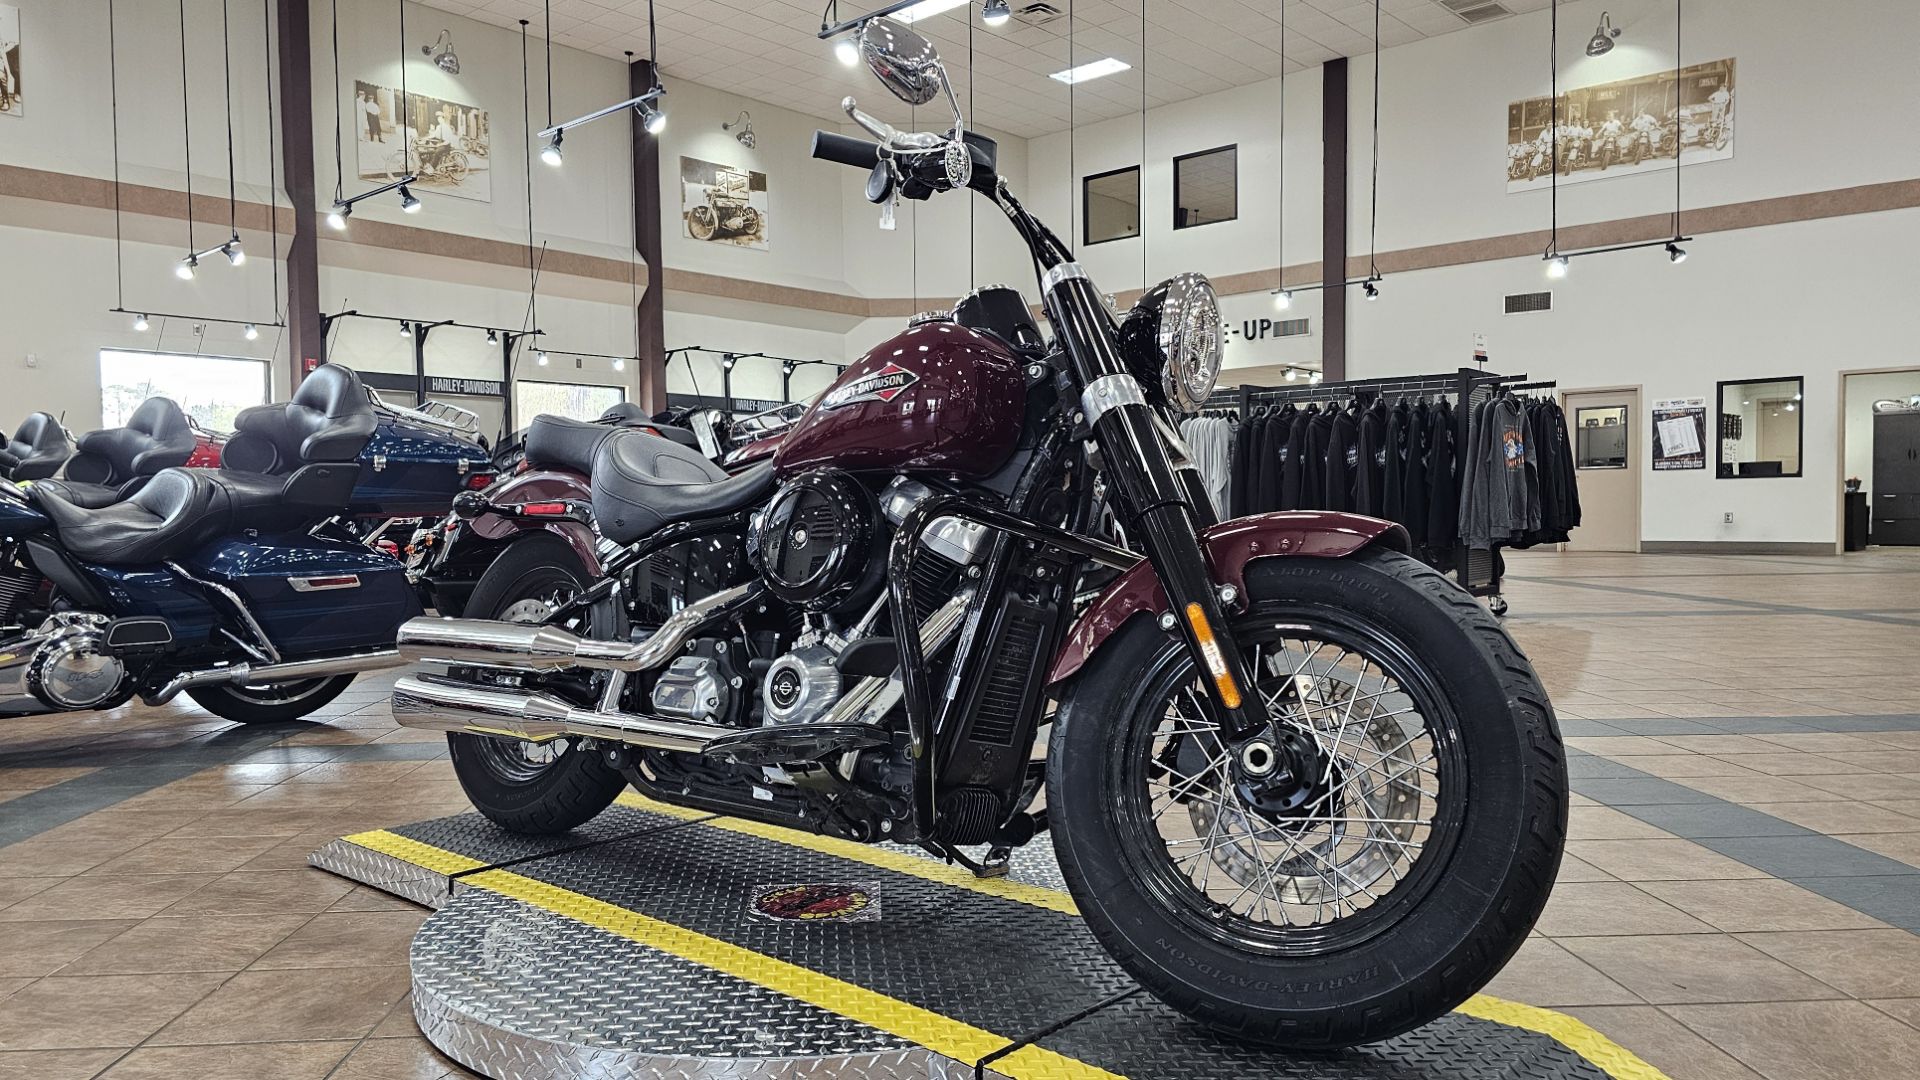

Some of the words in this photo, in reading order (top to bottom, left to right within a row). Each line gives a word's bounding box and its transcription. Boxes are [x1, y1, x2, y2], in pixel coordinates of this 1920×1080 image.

[432, 377, 501, 395] HARLEY-DAVIDSON
[827, 374, 904, 407] RLEY-DAVIDSON
[1155, 937, 1381, 994] HARLEY-DAVIDSON
